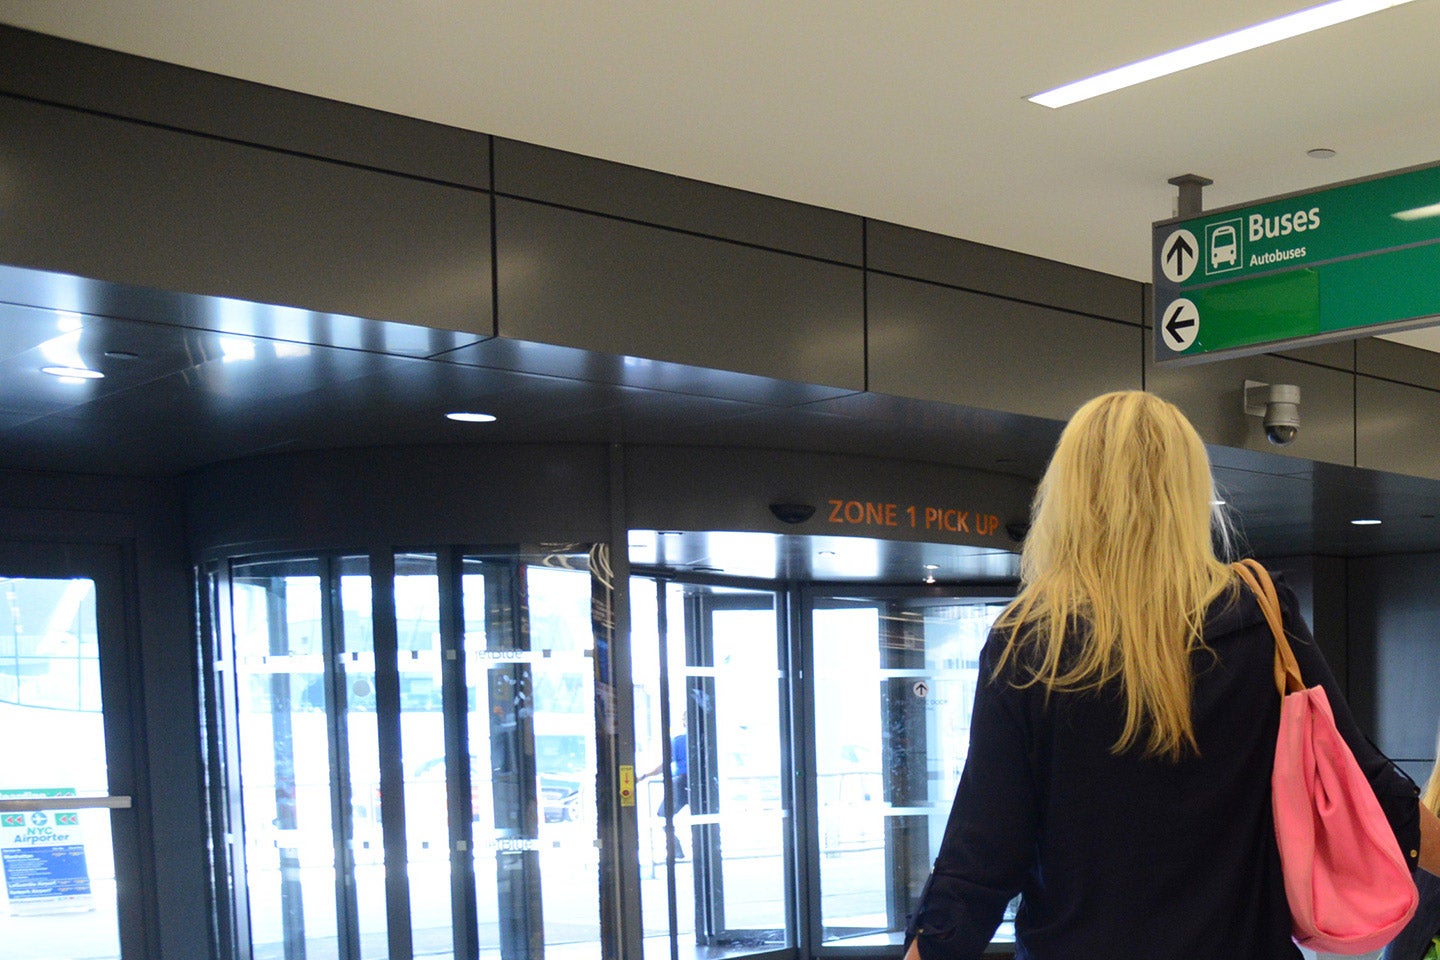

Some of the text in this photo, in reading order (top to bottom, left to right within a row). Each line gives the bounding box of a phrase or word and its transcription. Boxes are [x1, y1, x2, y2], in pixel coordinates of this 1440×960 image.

[1248, 207, 1321, 242] Buses
[1249, 247, 1307, 267] Autobuses
[828, 500, 999, 537] ZONE 1 PICK UP
[14, 834, 70, 845] Airporter
[27, 826, 53, 836] NYC
